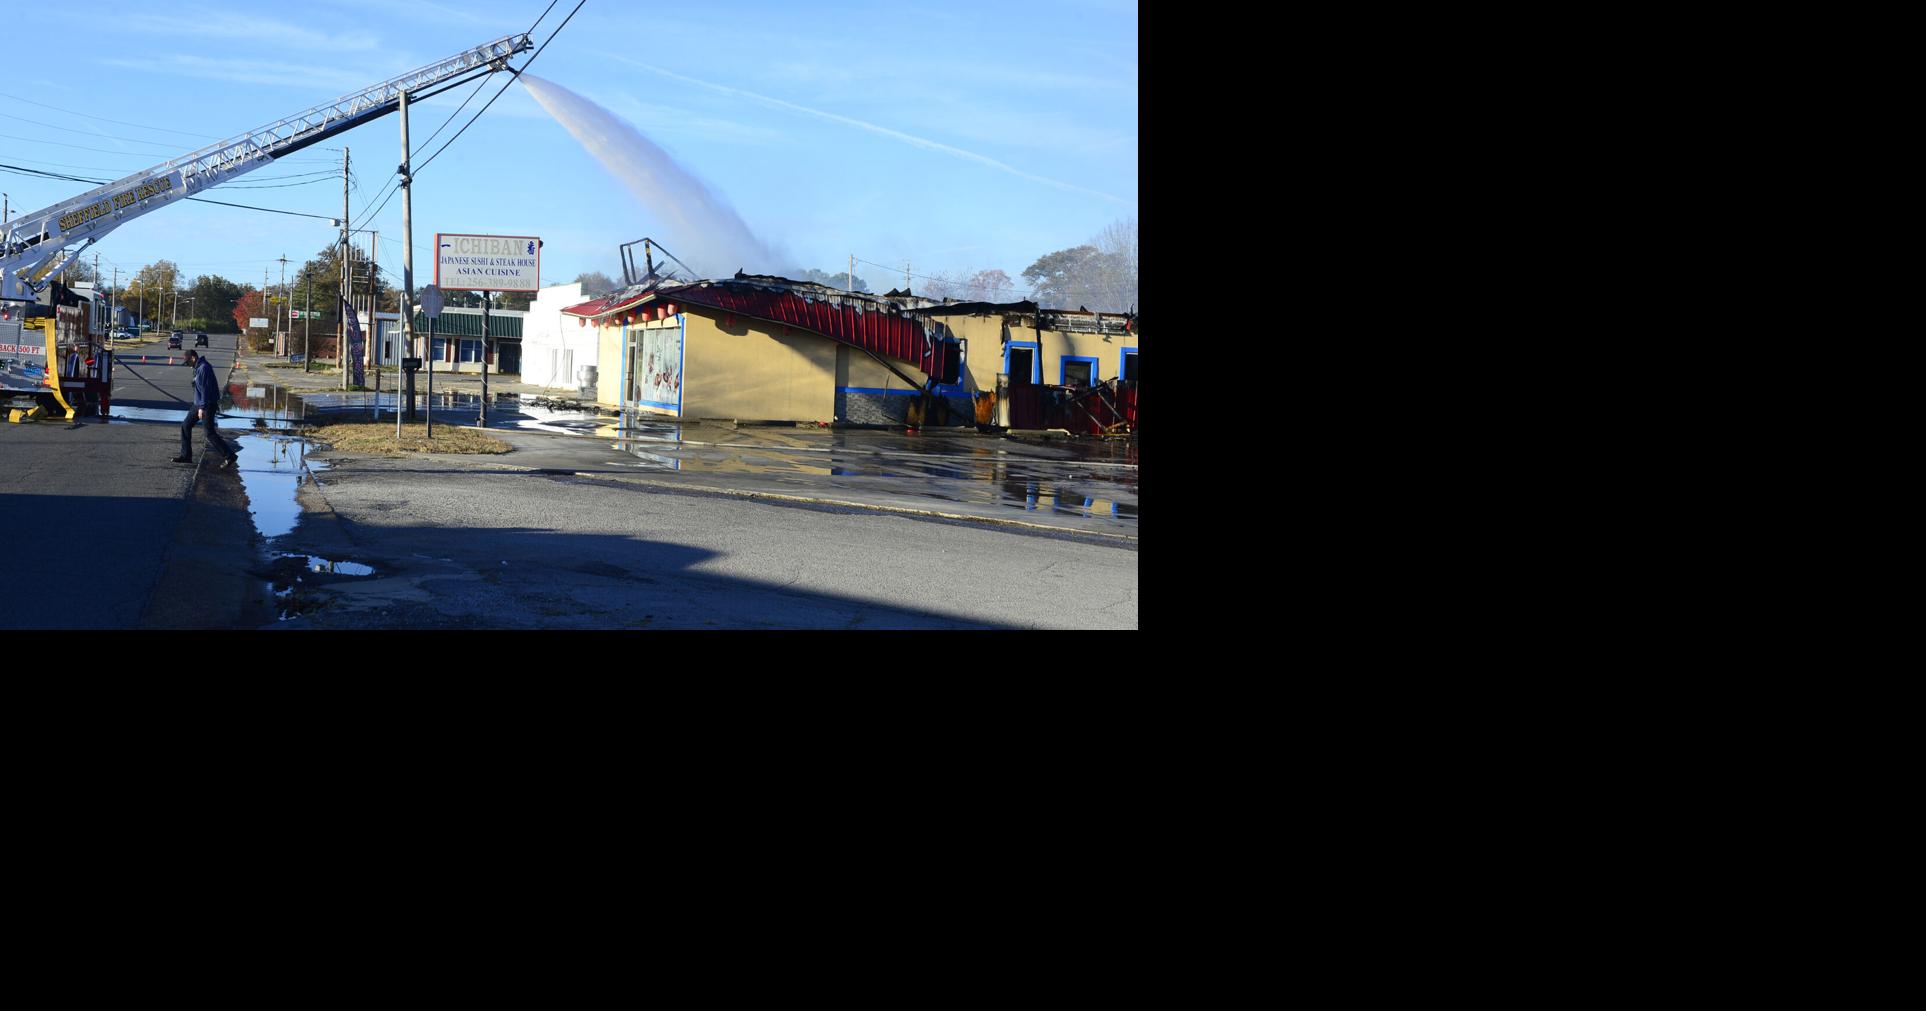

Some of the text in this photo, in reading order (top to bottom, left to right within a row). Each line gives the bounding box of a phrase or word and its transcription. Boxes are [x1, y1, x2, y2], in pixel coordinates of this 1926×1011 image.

[112, 191, 136, 210] FIRE
[136, 176, 172, 201] RESCUE
[454, 238, 524, 256] ICHIBAN
[440, 255, 469, 265] JAPANESE
[470, 256, 488, 266] SUSHI
[496, 257, 516, 267] STEAK
[517, 258, 536, 268] HOUSE
[484, 268, 521, 277] CUISINE
